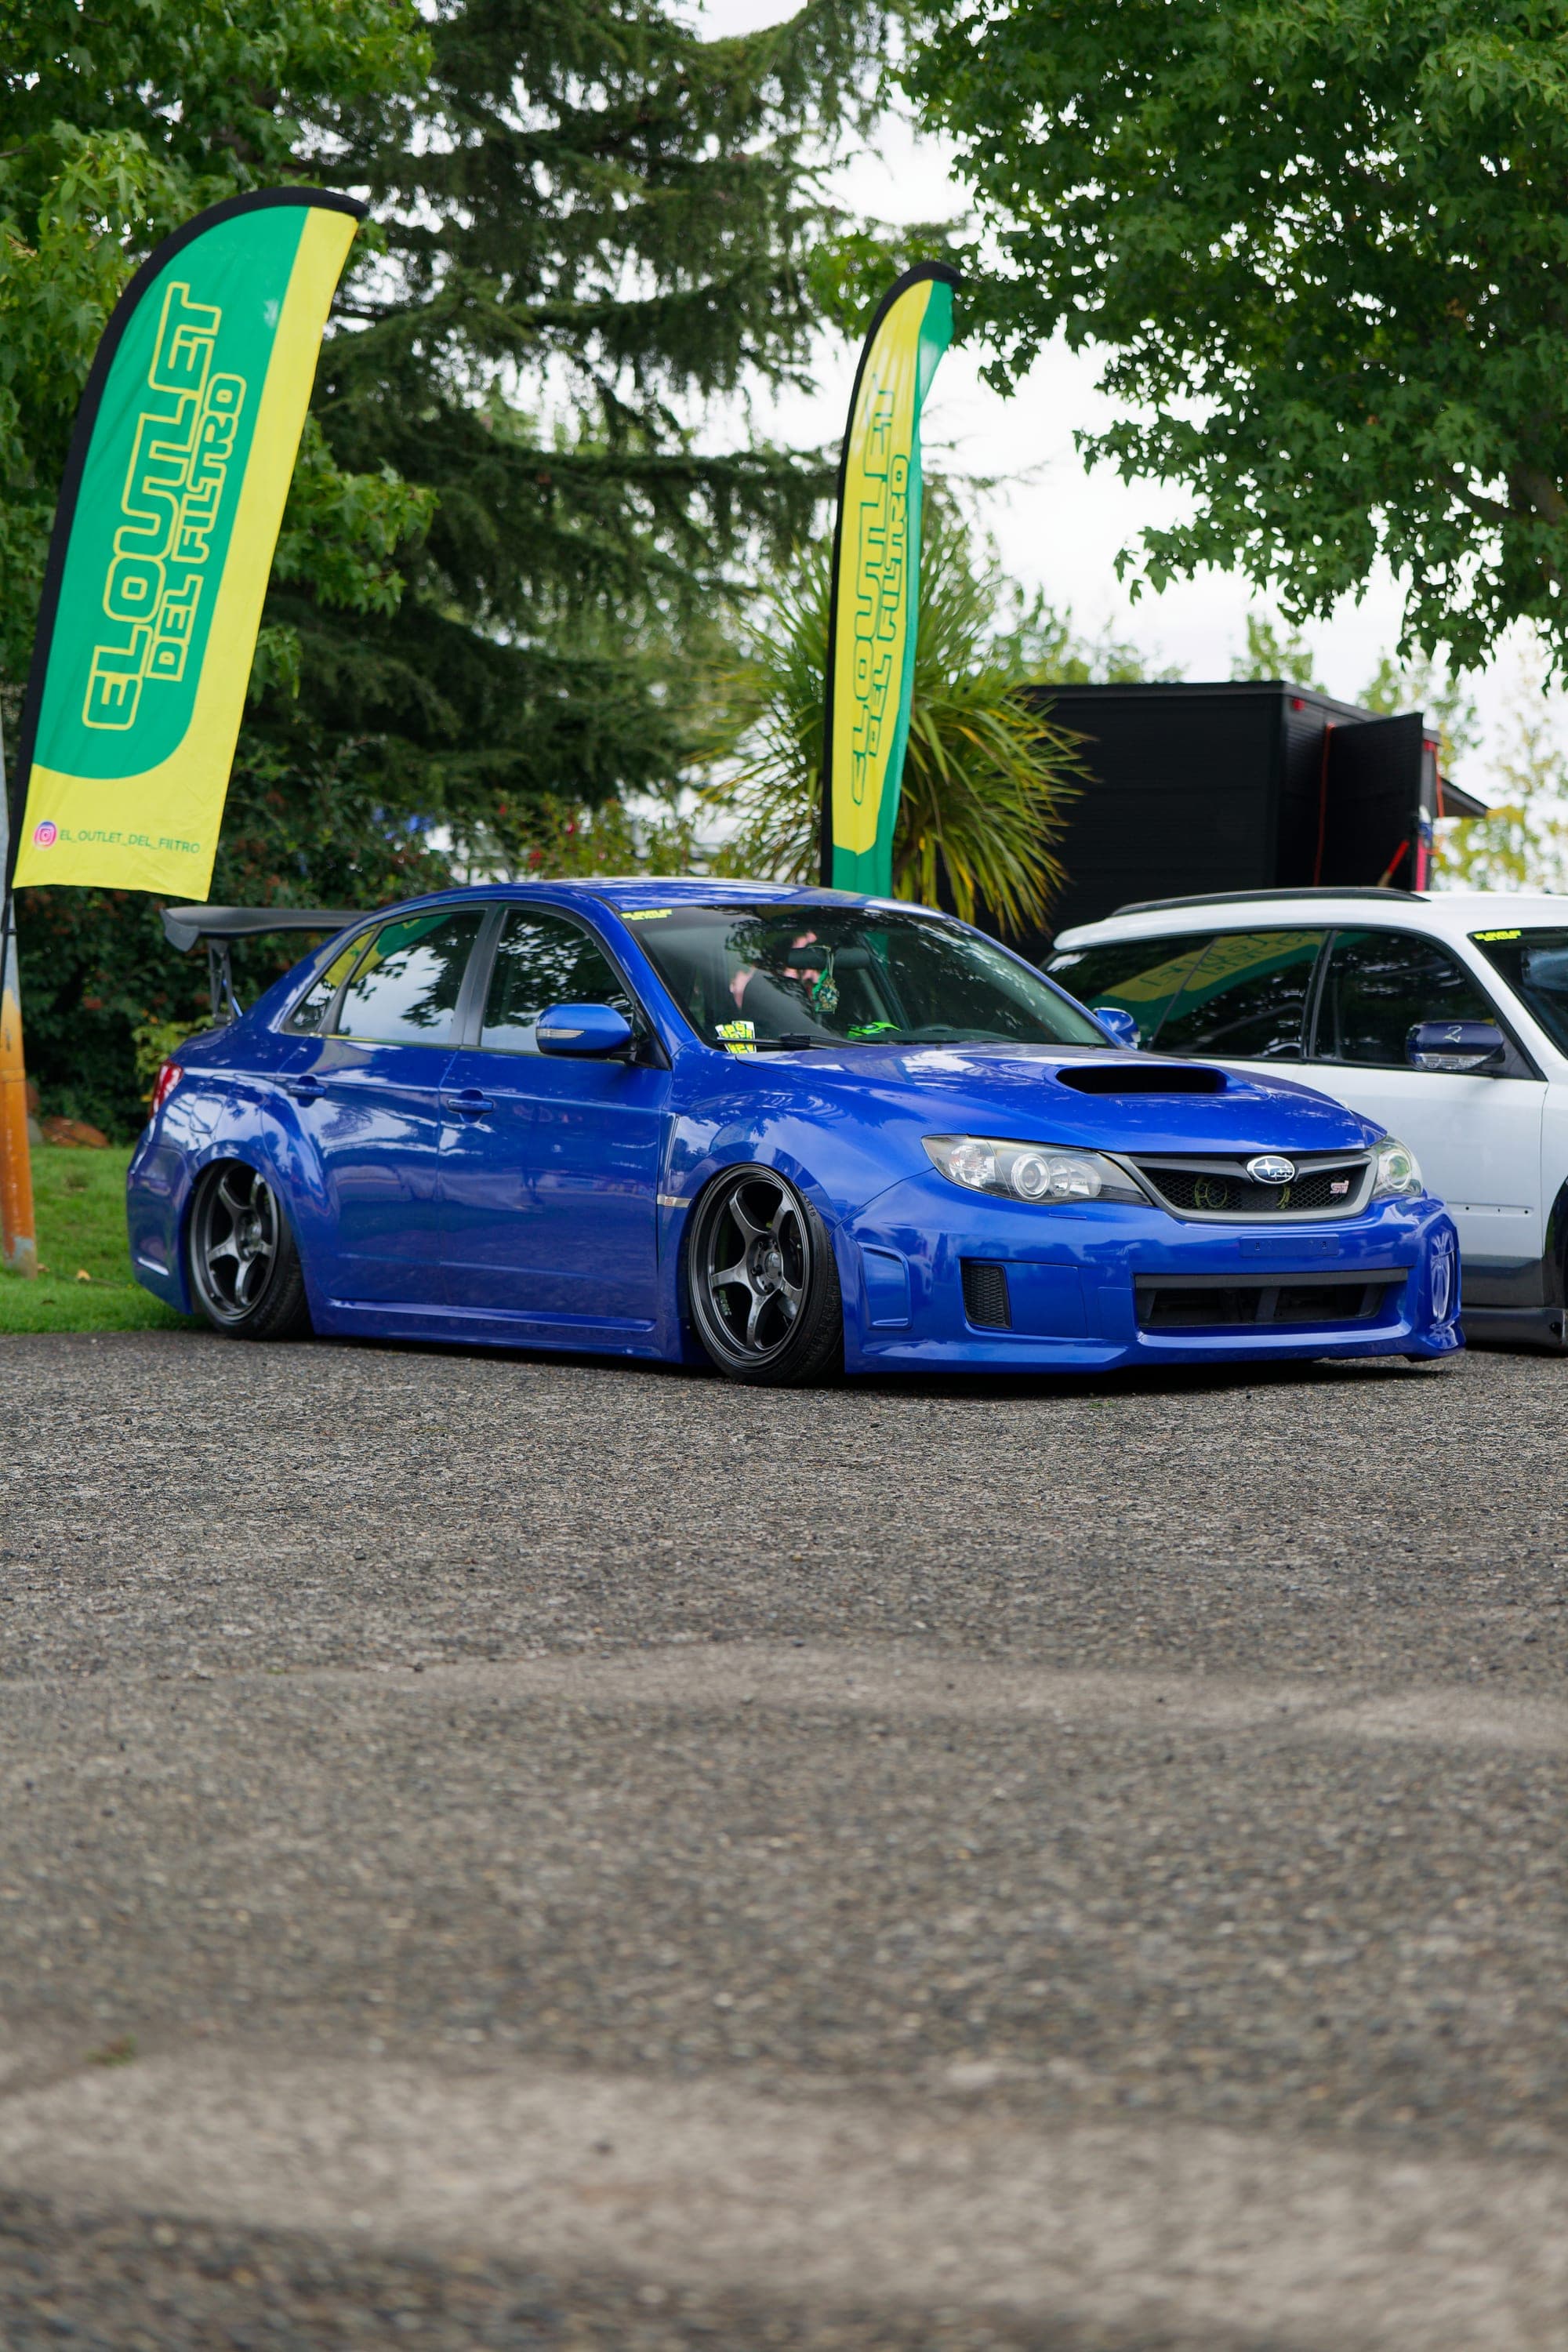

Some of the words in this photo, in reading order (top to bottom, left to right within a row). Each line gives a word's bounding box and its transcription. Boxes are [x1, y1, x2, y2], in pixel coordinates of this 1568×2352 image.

[103, 281, 221, 623] OUTLET
[171, 373, 247, 563] FILTRO
[853, 373, 895, 701] OUTLET
[144, 575, 204, 682] DEL
[877, 454, 909, 641] FILTRO
[82, 623, 153, 730] EL
